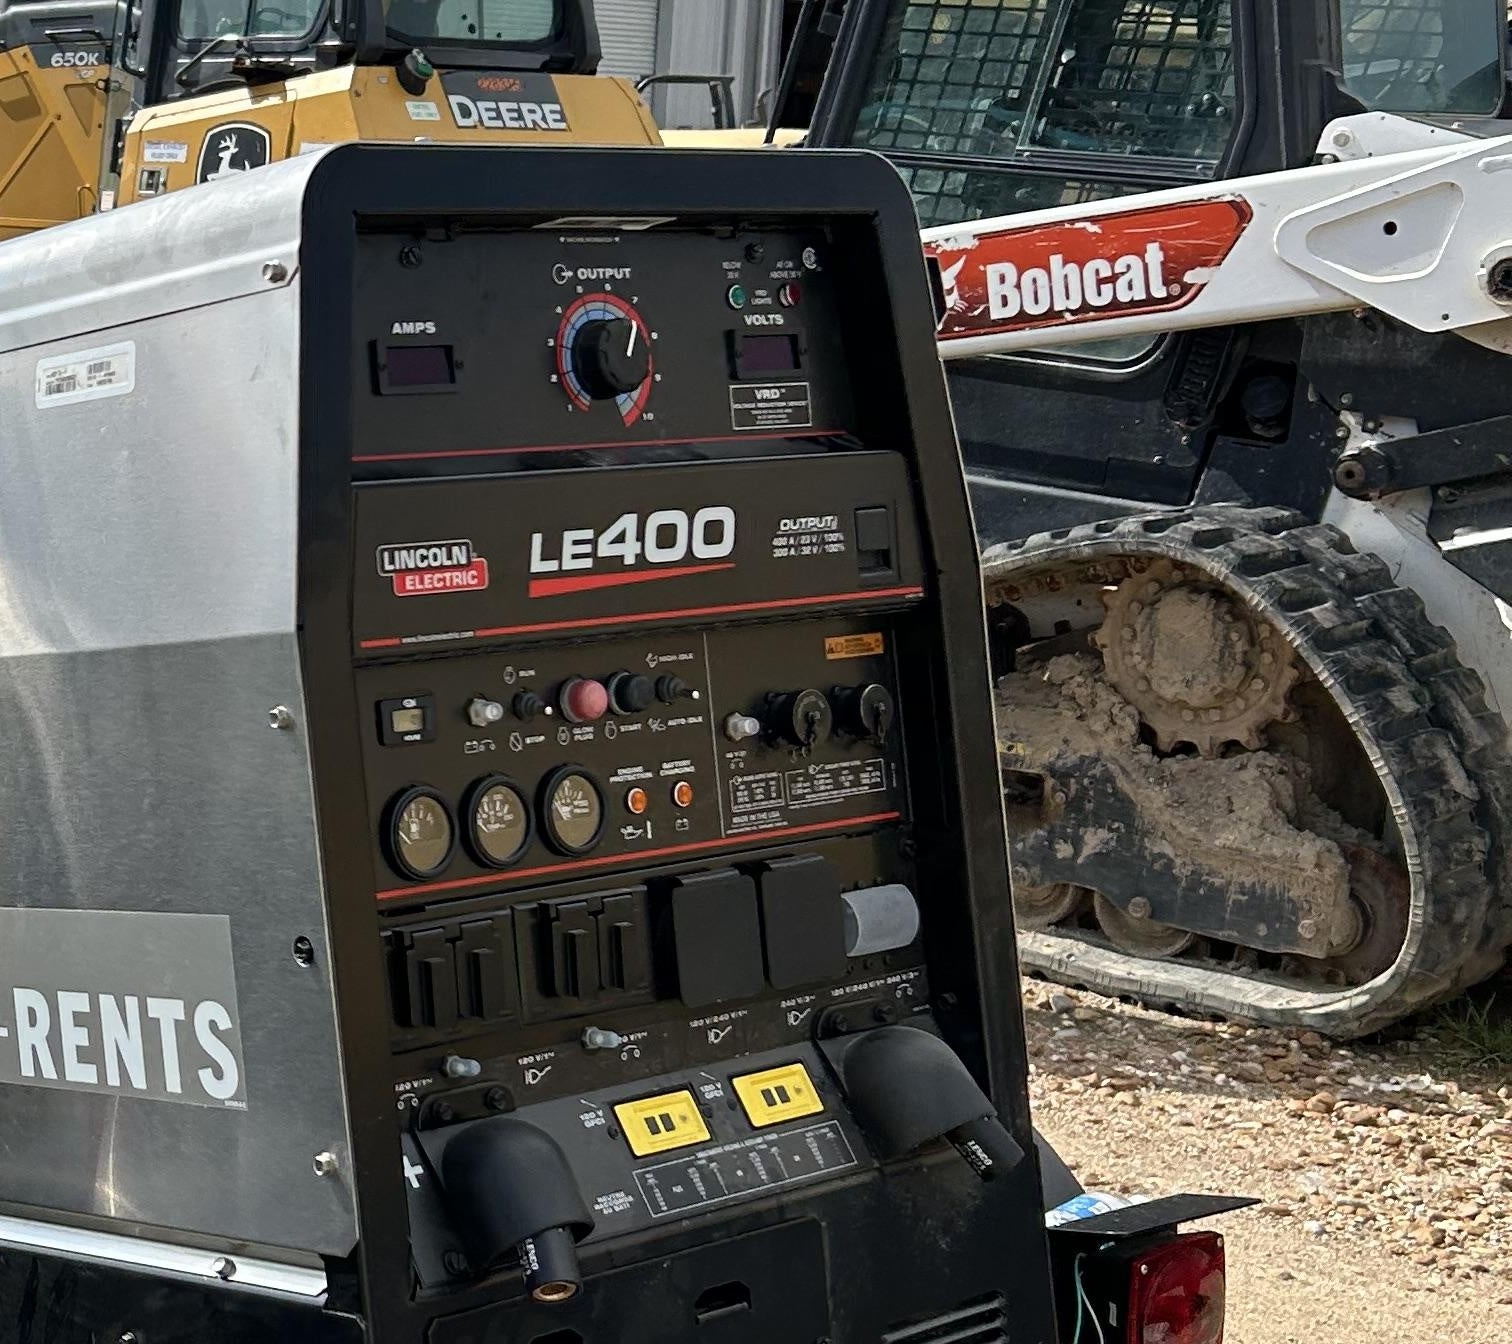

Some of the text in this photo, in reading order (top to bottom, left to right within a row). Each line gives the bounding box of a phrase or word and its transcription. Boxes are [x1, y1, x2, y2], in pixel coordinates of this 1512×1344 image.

[51, 51, 98, 67] 650K
[447, 95, 567, 128] DEERE
[577, 268, 632, 279] OUTPUT
[986, 242, 1167, 321] Bobcat
[392, 321, 436, 335] AMPS
[744, 314, 784, 325] VOLTS
[780, 515, 834, 531] OUTPUT
[530, 506, 735, 573] LE400
[383, 545, 467, 571] LINCOLN
[405, 570, 478, 590] ELECTRIC
